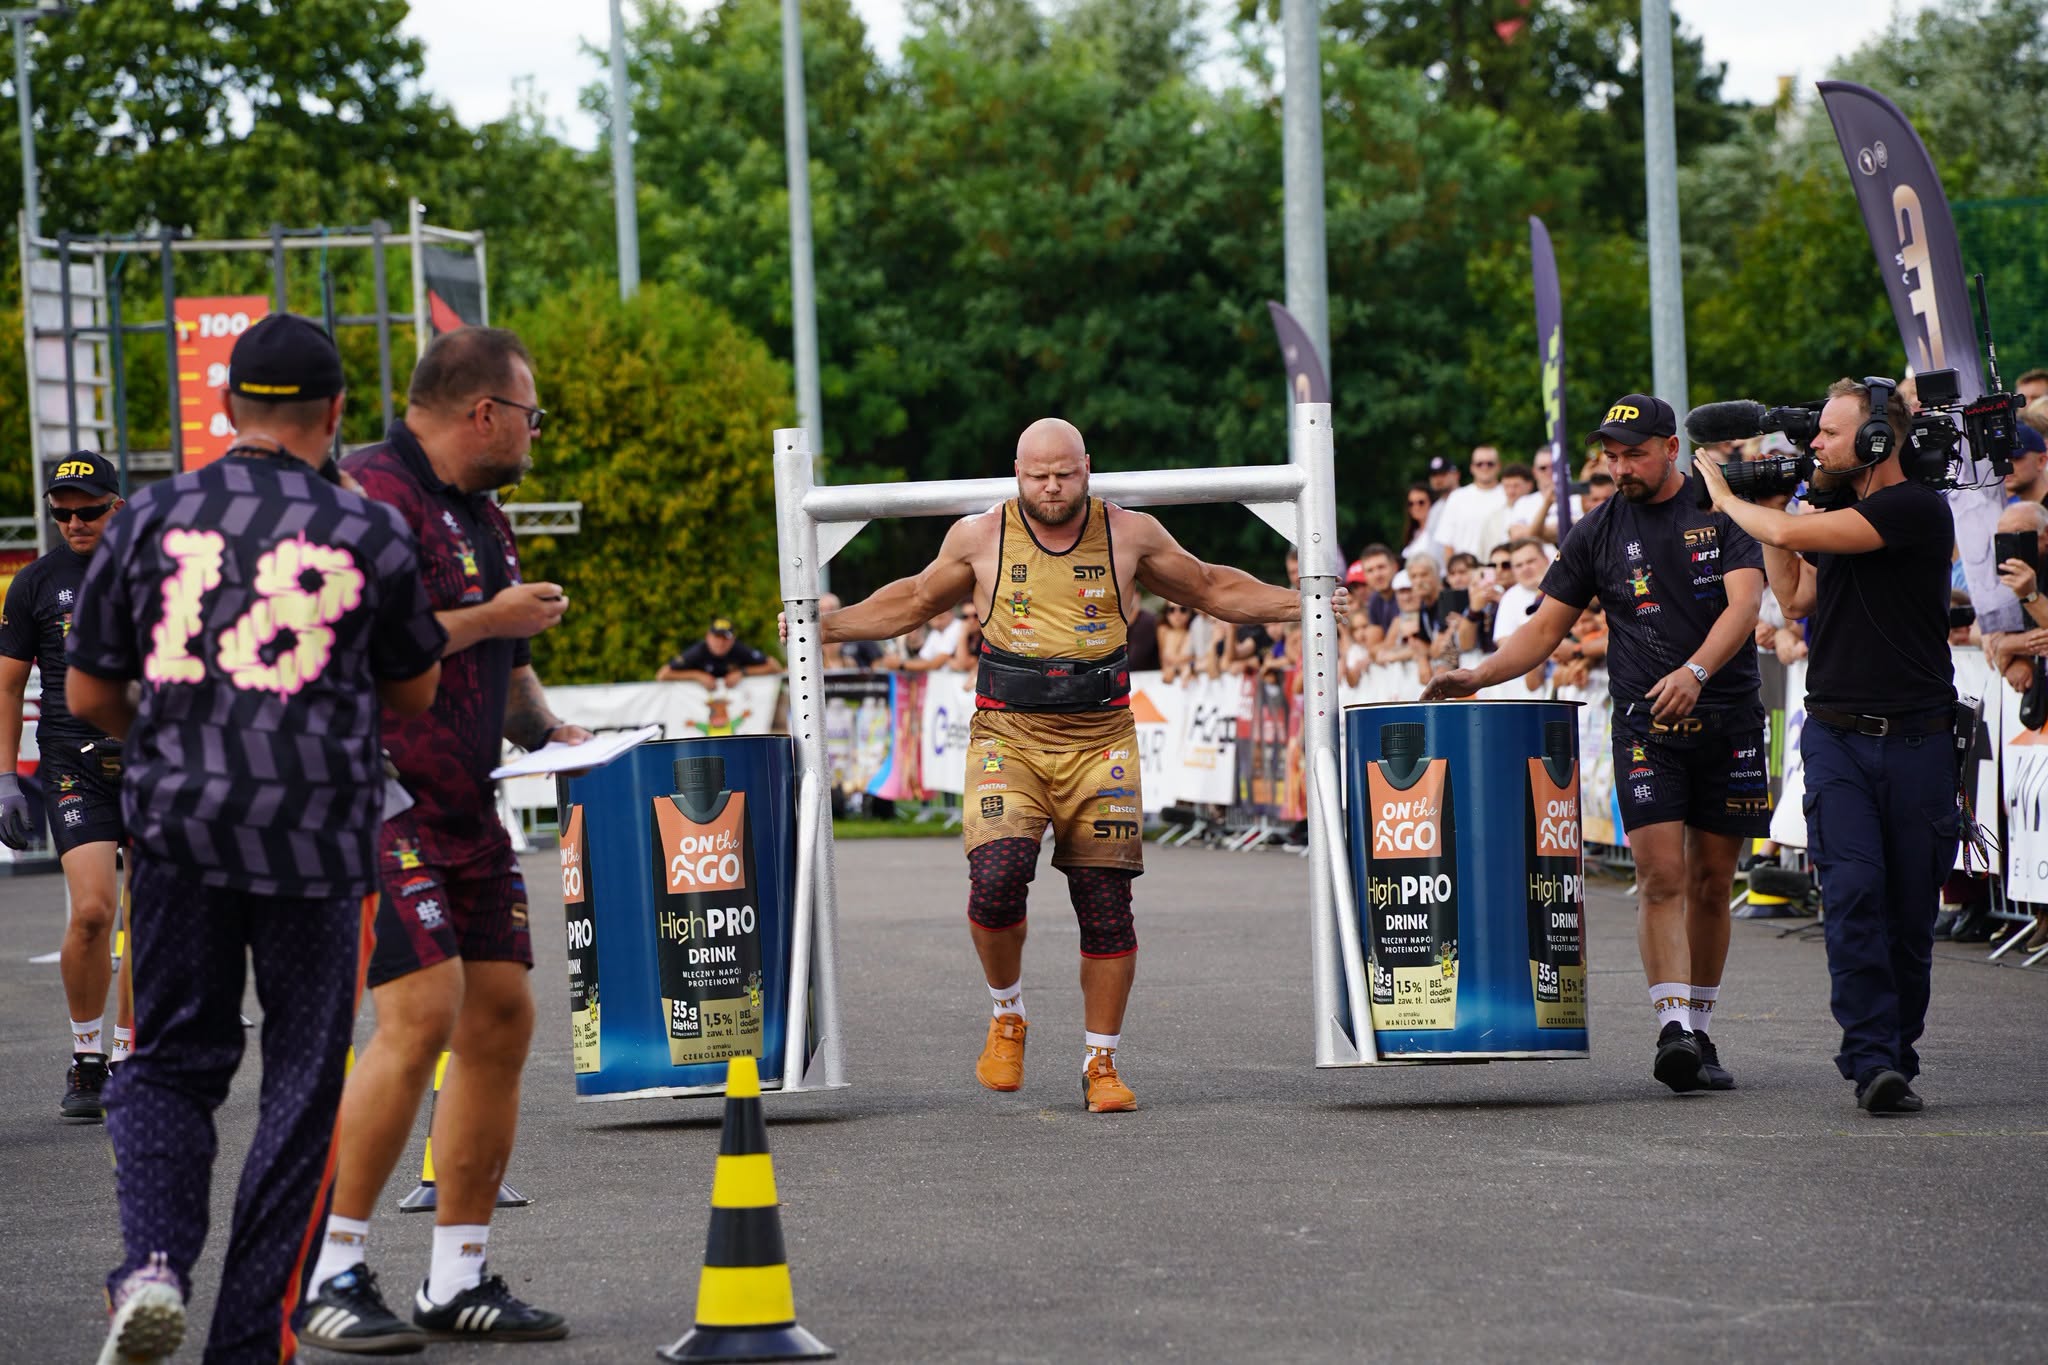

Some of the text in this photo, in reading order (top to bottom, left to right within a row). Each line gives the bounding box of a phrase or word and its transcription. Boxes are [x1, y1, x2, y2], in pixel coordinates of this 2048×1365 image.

[199, 312, 250, 338] 100
[207, 362, 230, 387] 9
[1605, 405, 1639, 421] STP
[209, 412, 237, 437] 8
[56, 461, 94, 477] STP
[1684, 526, 1716, 545] STP
[1692, 547, 1720, 562] Hurst
[1073, 566, 1106, 579] STP
[1693, 574, 1722, 586] efectiv
[1078, 588, 1105, 598] Hurst
[146, 529, 365, 695] 18
[1110, 805, 1136, 813] Baster
[1382, 797, 1438, 820] ON the
[1547, 800, 1568, 818] ON
[1093, 820, 1138, 839] STP
[1394, 821, 1437, 851] GO
[1557, 820, 1579, 850] GO
[680, 829, 740, 854] ON the
[696, 853, 740, 884] GO
[563, 866, 581, 897] GO
[1367, 873, 1452, 910] HighPRO
[659, 905, 755, 945] HighPRO
[1385, 914, 1429, 931] DRINK
[1551, 912, 1579, 929] DRINK
[688, 945, 737, 965] DRINK
[1385, 945, 1431, 954] PROTEINOWY
[688, 977, 740, 988] PROTEINOWY
[672, 1019, 699, 1031] białka
